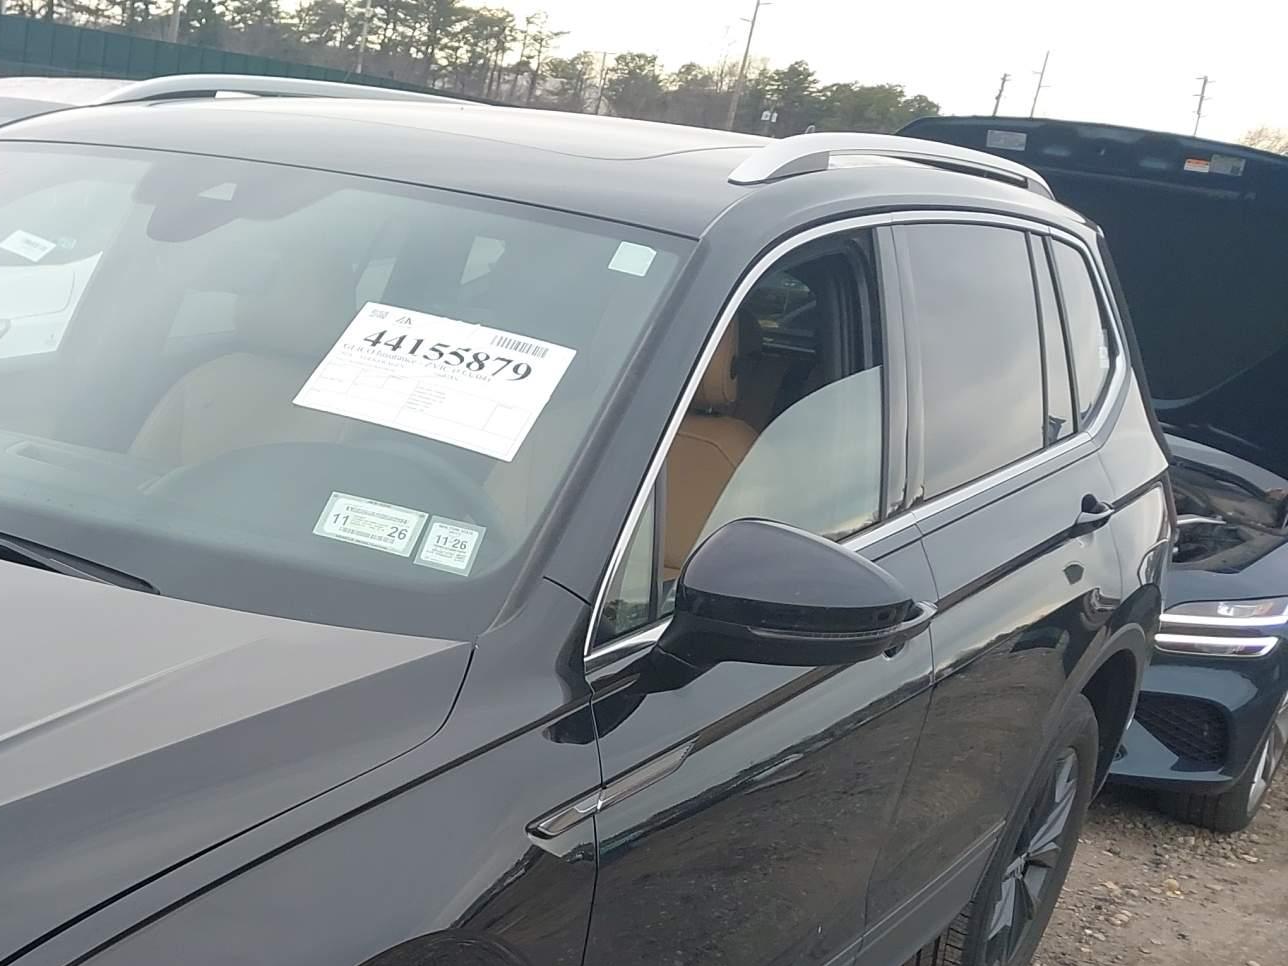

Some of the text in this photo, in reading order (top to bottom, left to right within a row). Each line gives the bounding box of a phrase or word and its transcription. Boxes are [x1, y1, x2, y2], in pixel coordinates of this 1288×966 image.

[363, 329, 532, 381] 44155879
[332, 513, 350, 526] 11
[387, 526, 408, 541] 26
